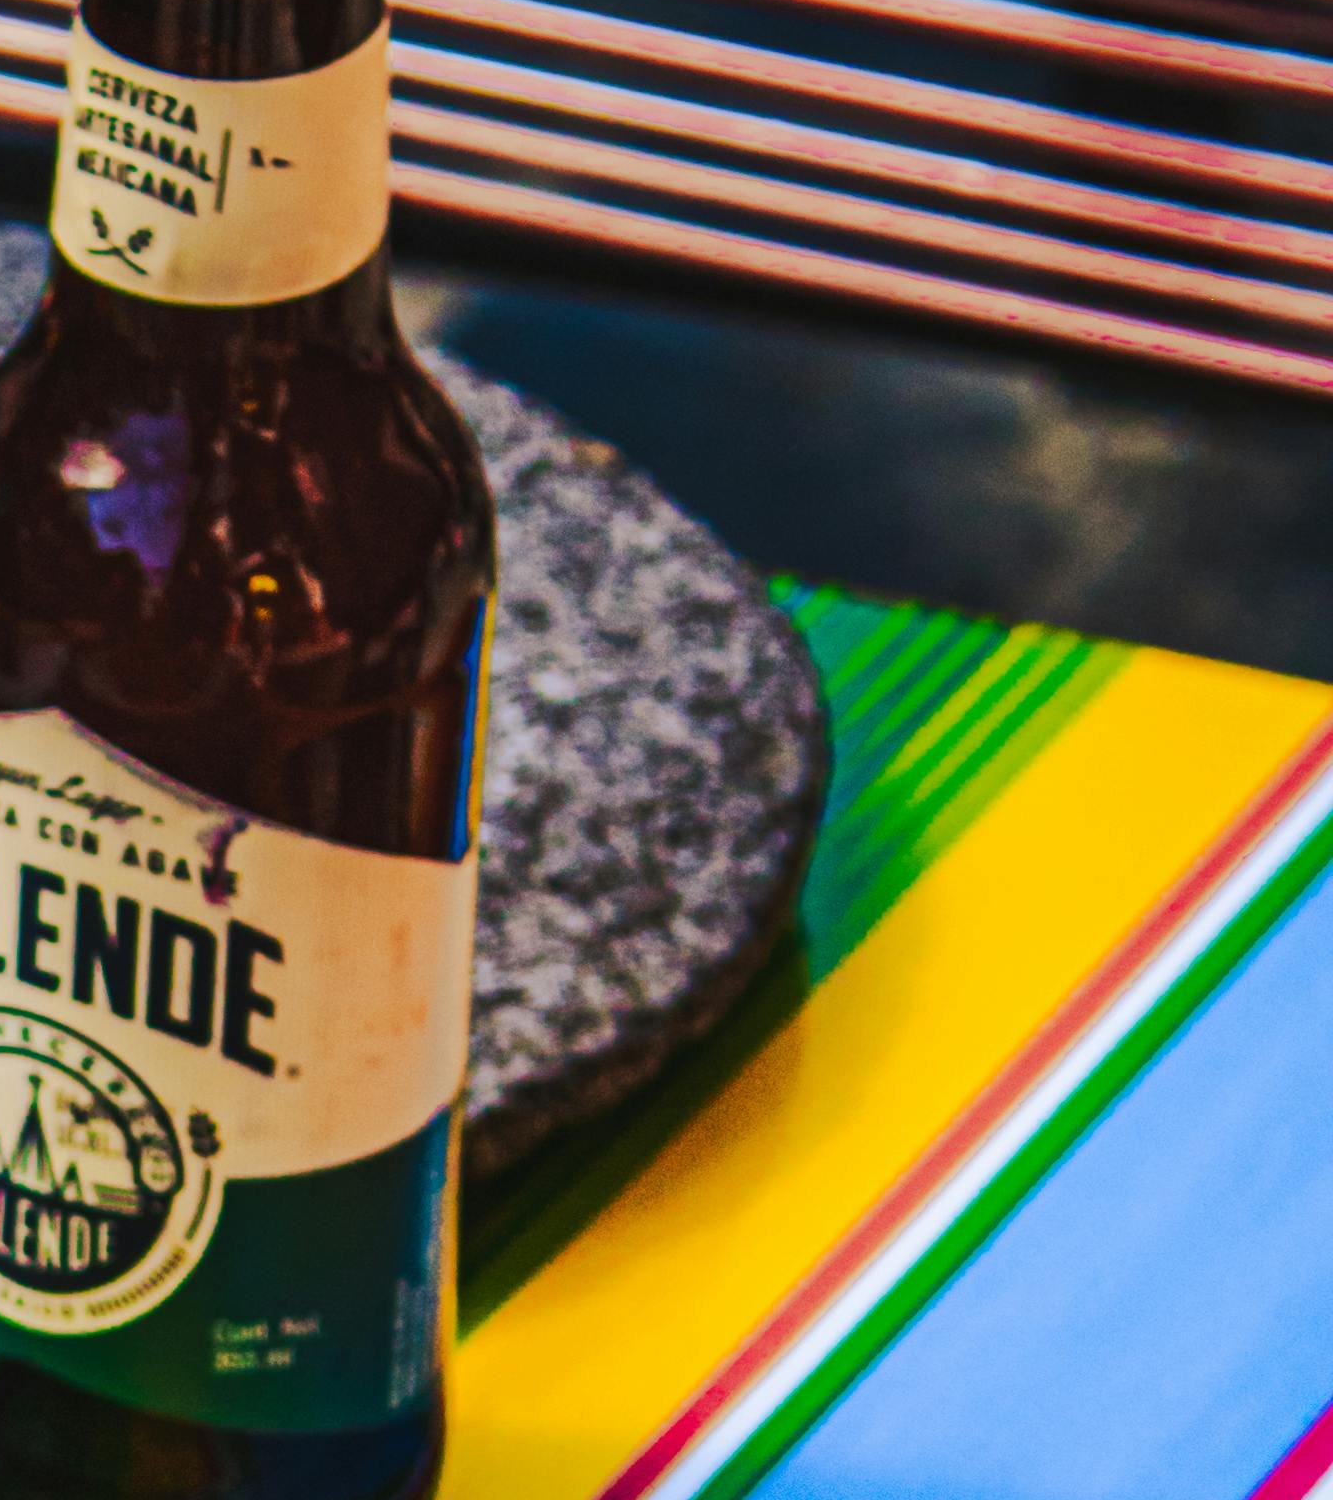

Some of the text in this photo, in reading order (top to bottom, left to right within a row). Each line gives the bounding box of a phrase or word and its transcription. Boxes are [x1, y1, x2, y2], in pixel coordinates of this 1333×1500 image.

[88, 67, 198, 134] CERVEZA
[75, 105, 215, 183] ARTESANAL
[76, 148, 198, 217] MEXICANA
[38, 816, 99, 857] CON
